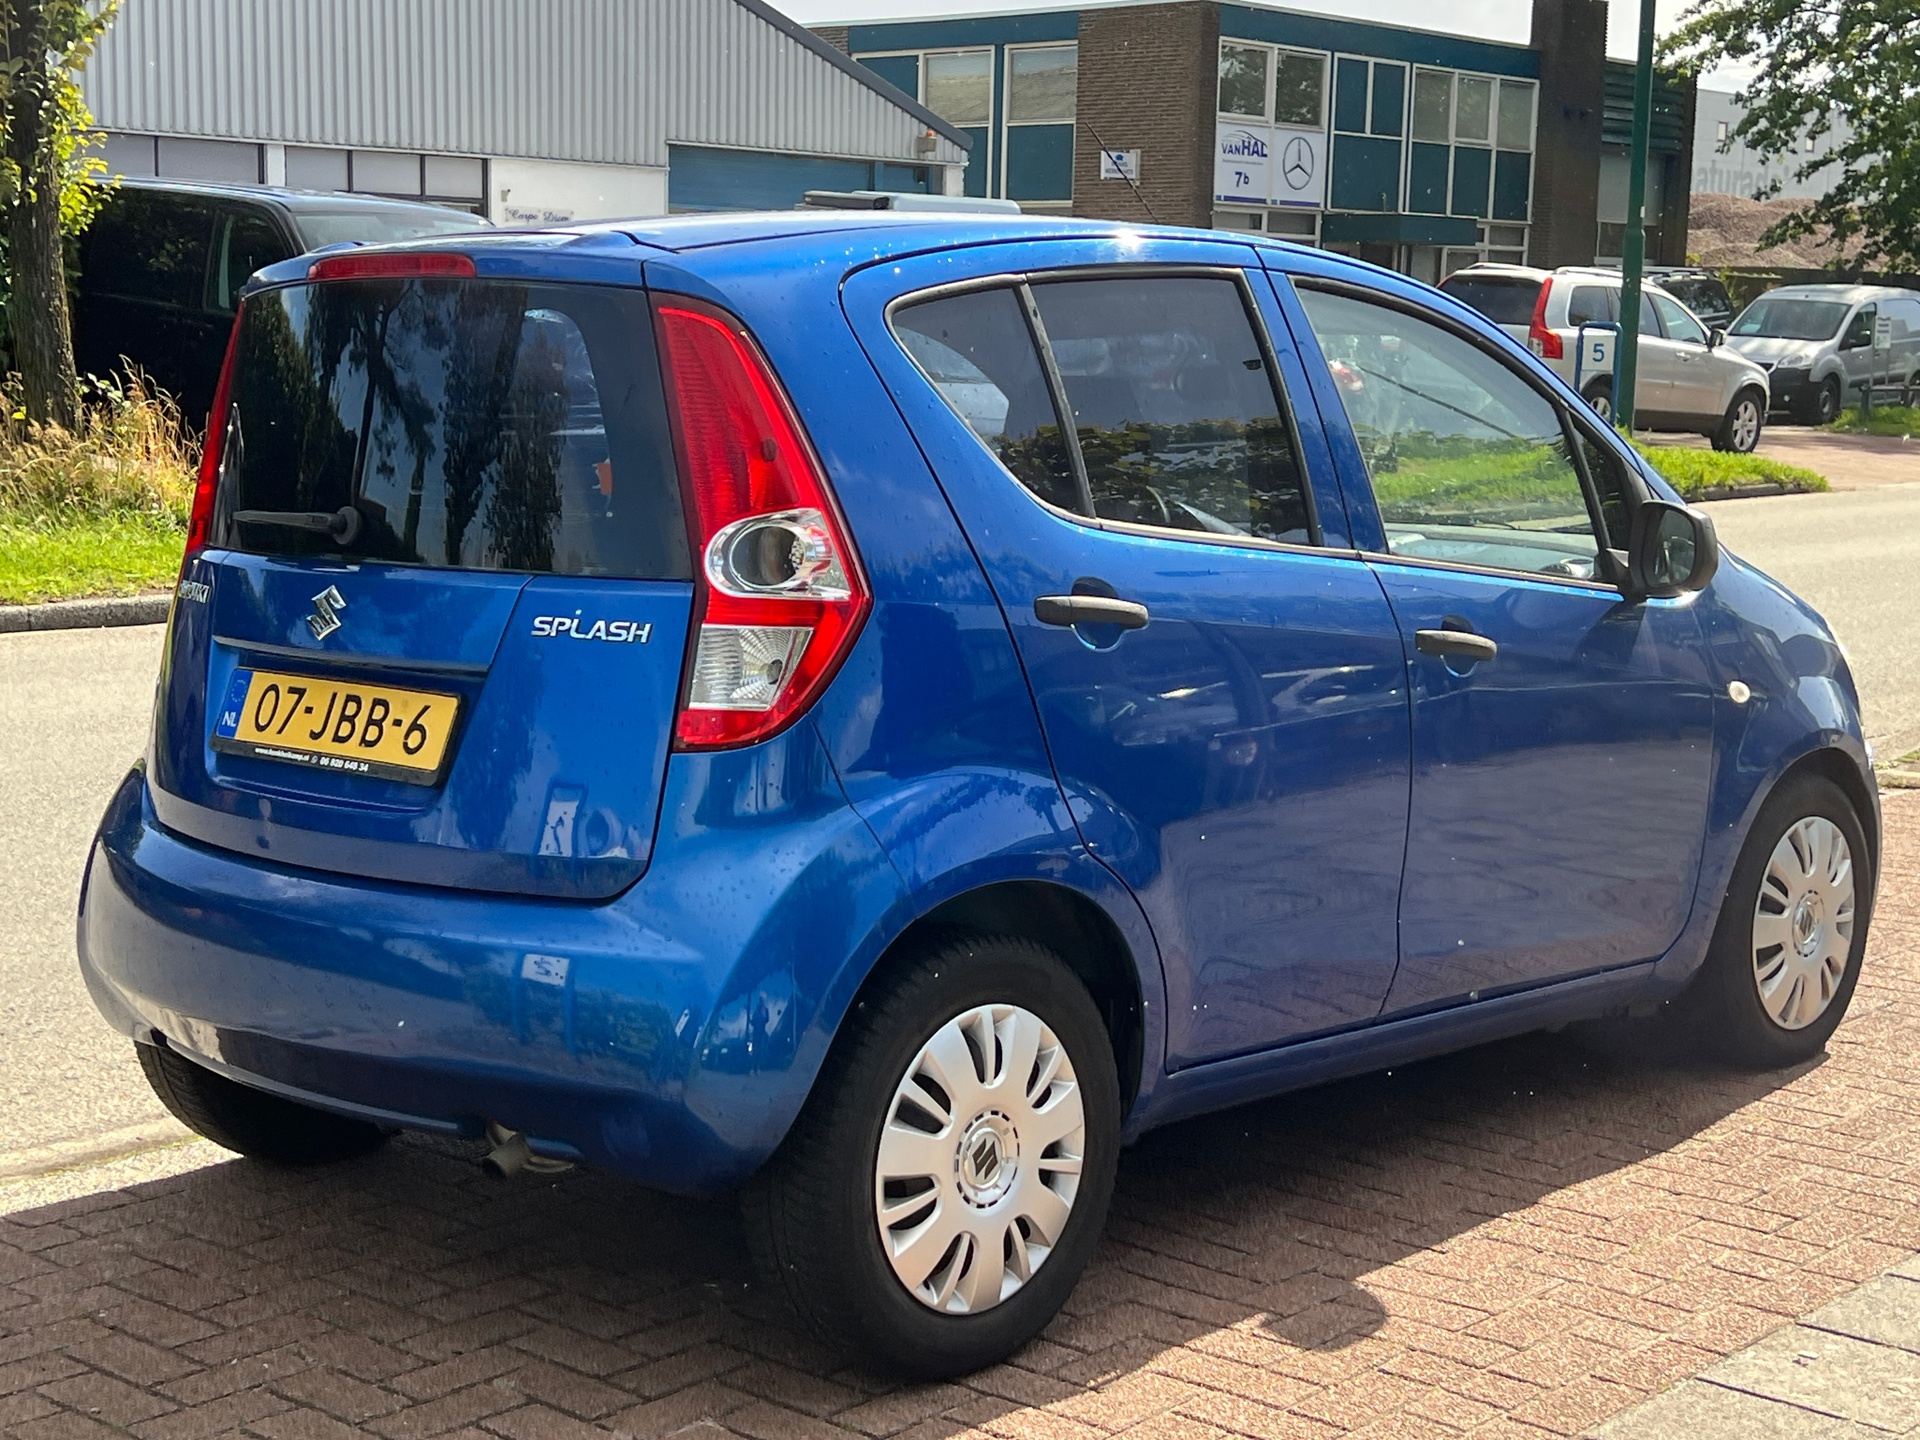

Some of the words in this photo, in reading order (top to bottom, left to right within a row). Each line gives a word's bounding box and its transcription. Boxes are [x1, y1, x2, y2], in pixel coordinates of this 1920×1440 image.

[1234, 170, 1250, 188] 7b
[1592, 342, 1605, 363] 5
[531, 609, 652, 643] SPLASH
[221, 710, 237, 728] NL
[253, 682, 432, 756] 07-JBB-6
